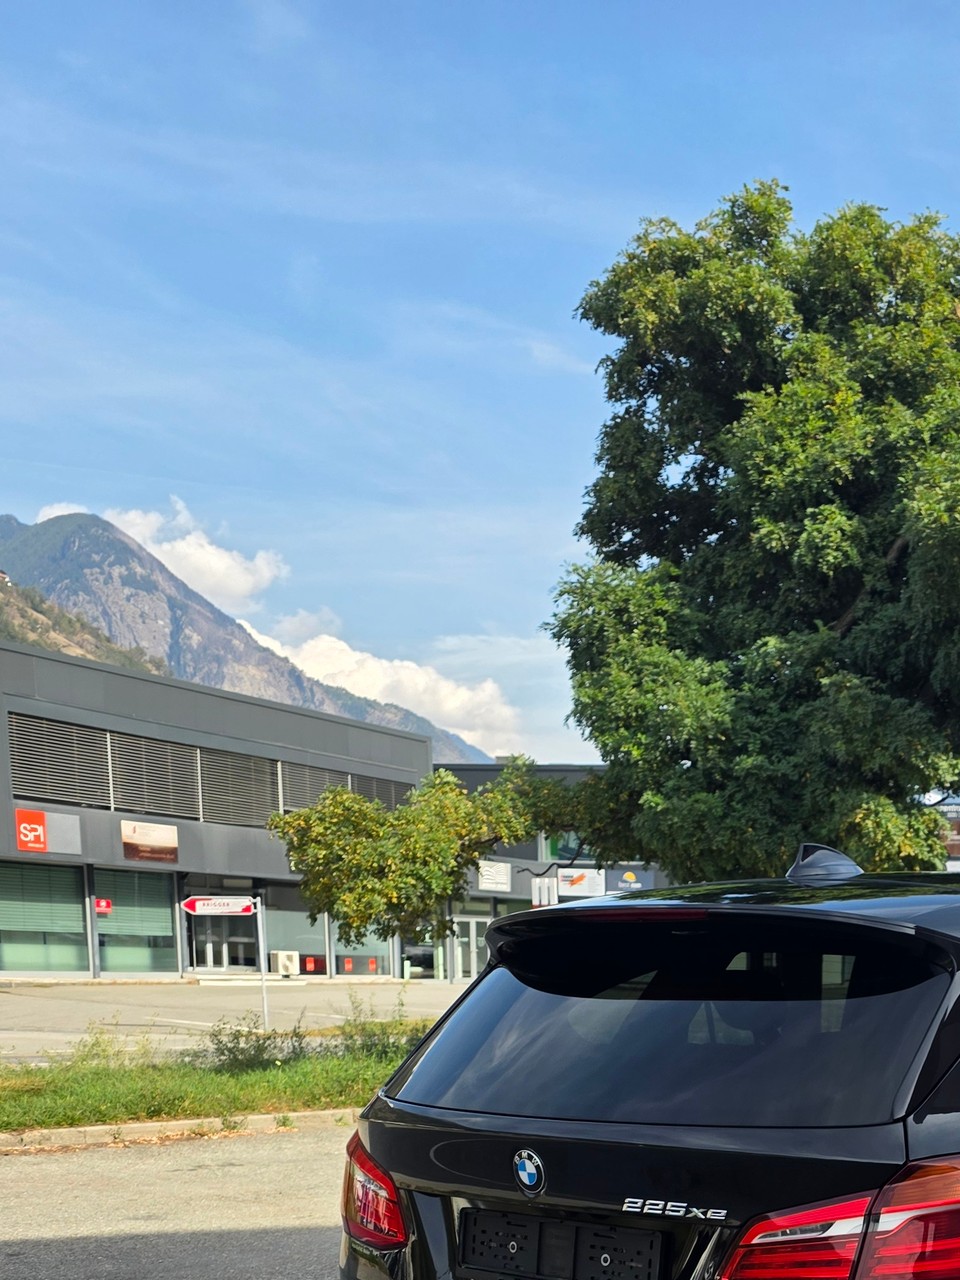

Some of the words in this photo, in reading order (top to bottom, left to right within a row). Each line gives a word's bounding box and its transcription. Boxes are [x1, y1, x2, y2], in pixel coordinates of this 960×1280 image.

[19, 823, 44, 842] SPI
[513, 1150, 540, 1168] BMW
[621, 1197, 728, 1221] 225xe
